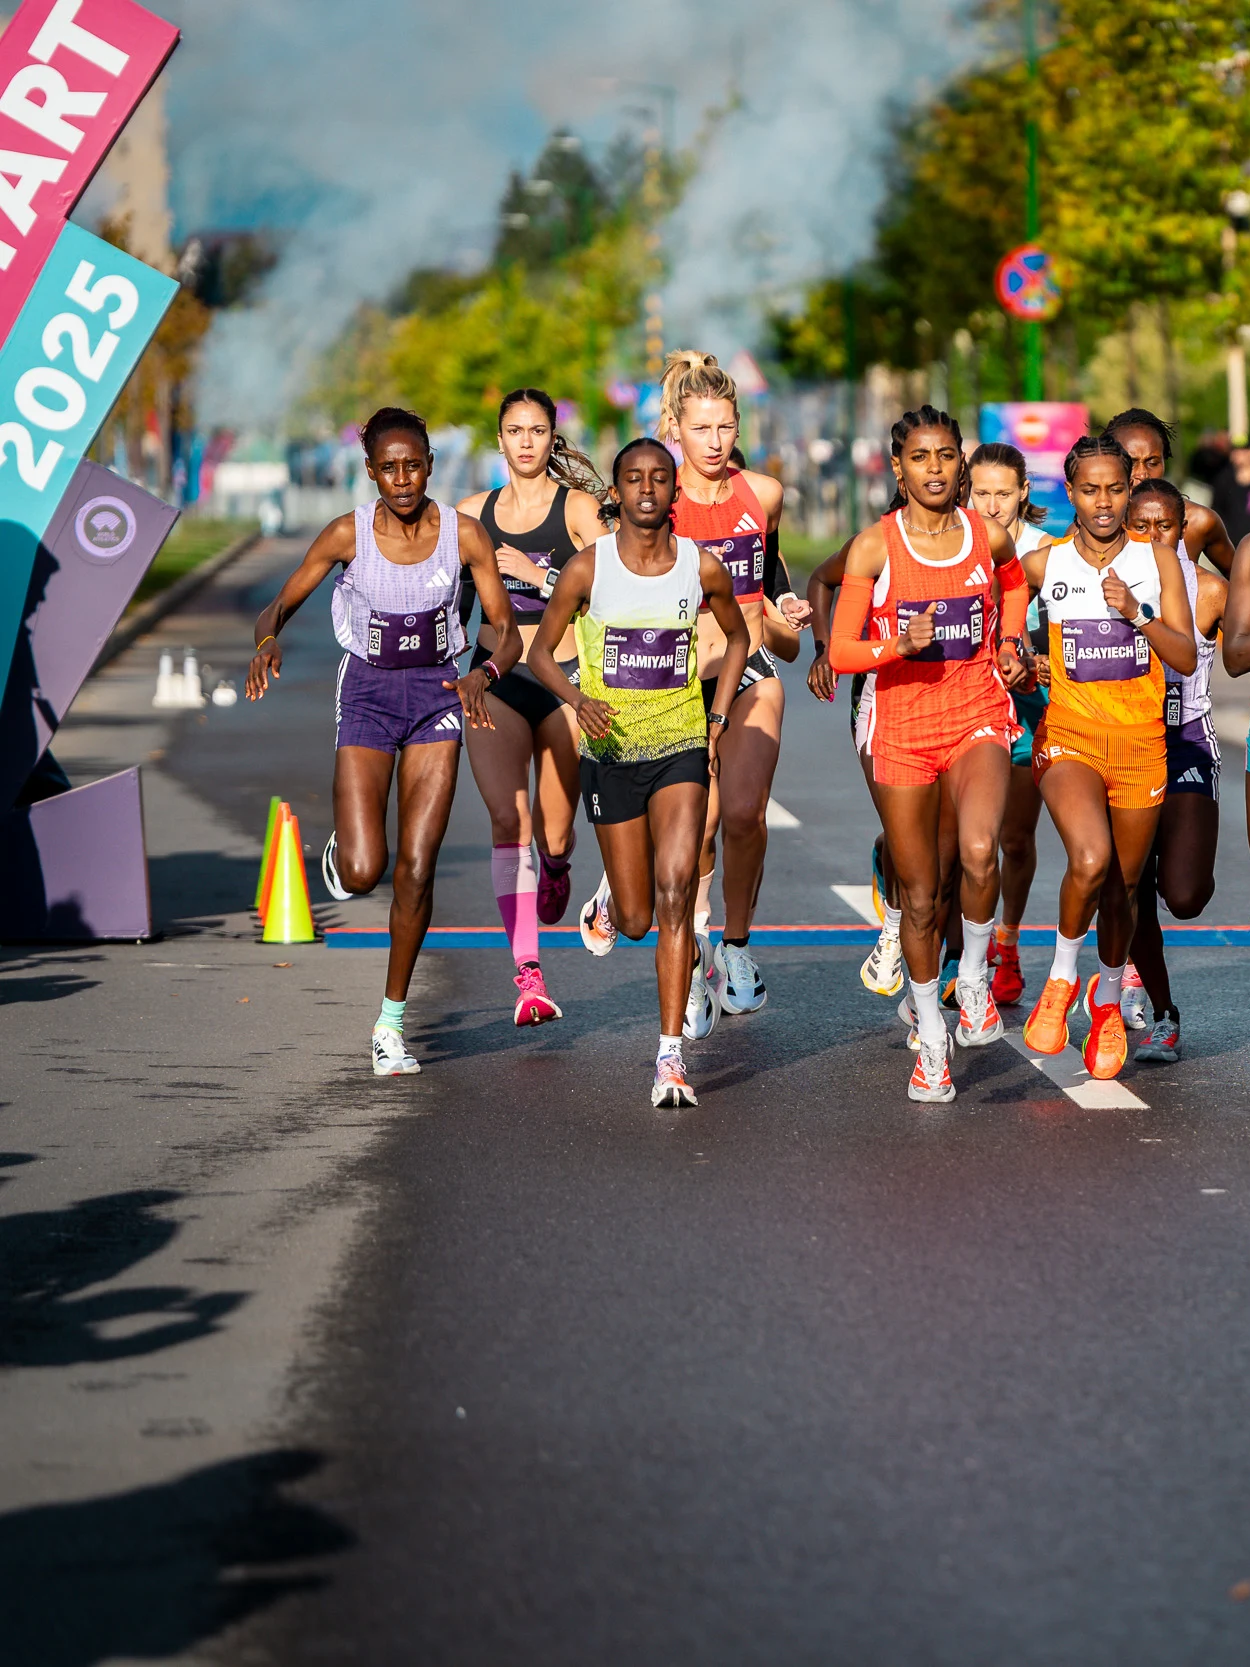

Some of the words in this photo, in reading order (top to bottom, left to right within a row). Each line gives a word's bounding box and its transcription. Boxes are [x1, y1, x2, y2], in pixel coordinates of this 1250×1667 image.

[0, 0, 130, 271] ART
[0, 259, 139, 491] 2025
[931, 623, 971, 641] DINA
[398, 634, 421, 651] 28
[619, 653, 674, 669] SAMIYAH
[1076, 645, 1135, 660] ASAYIECH
